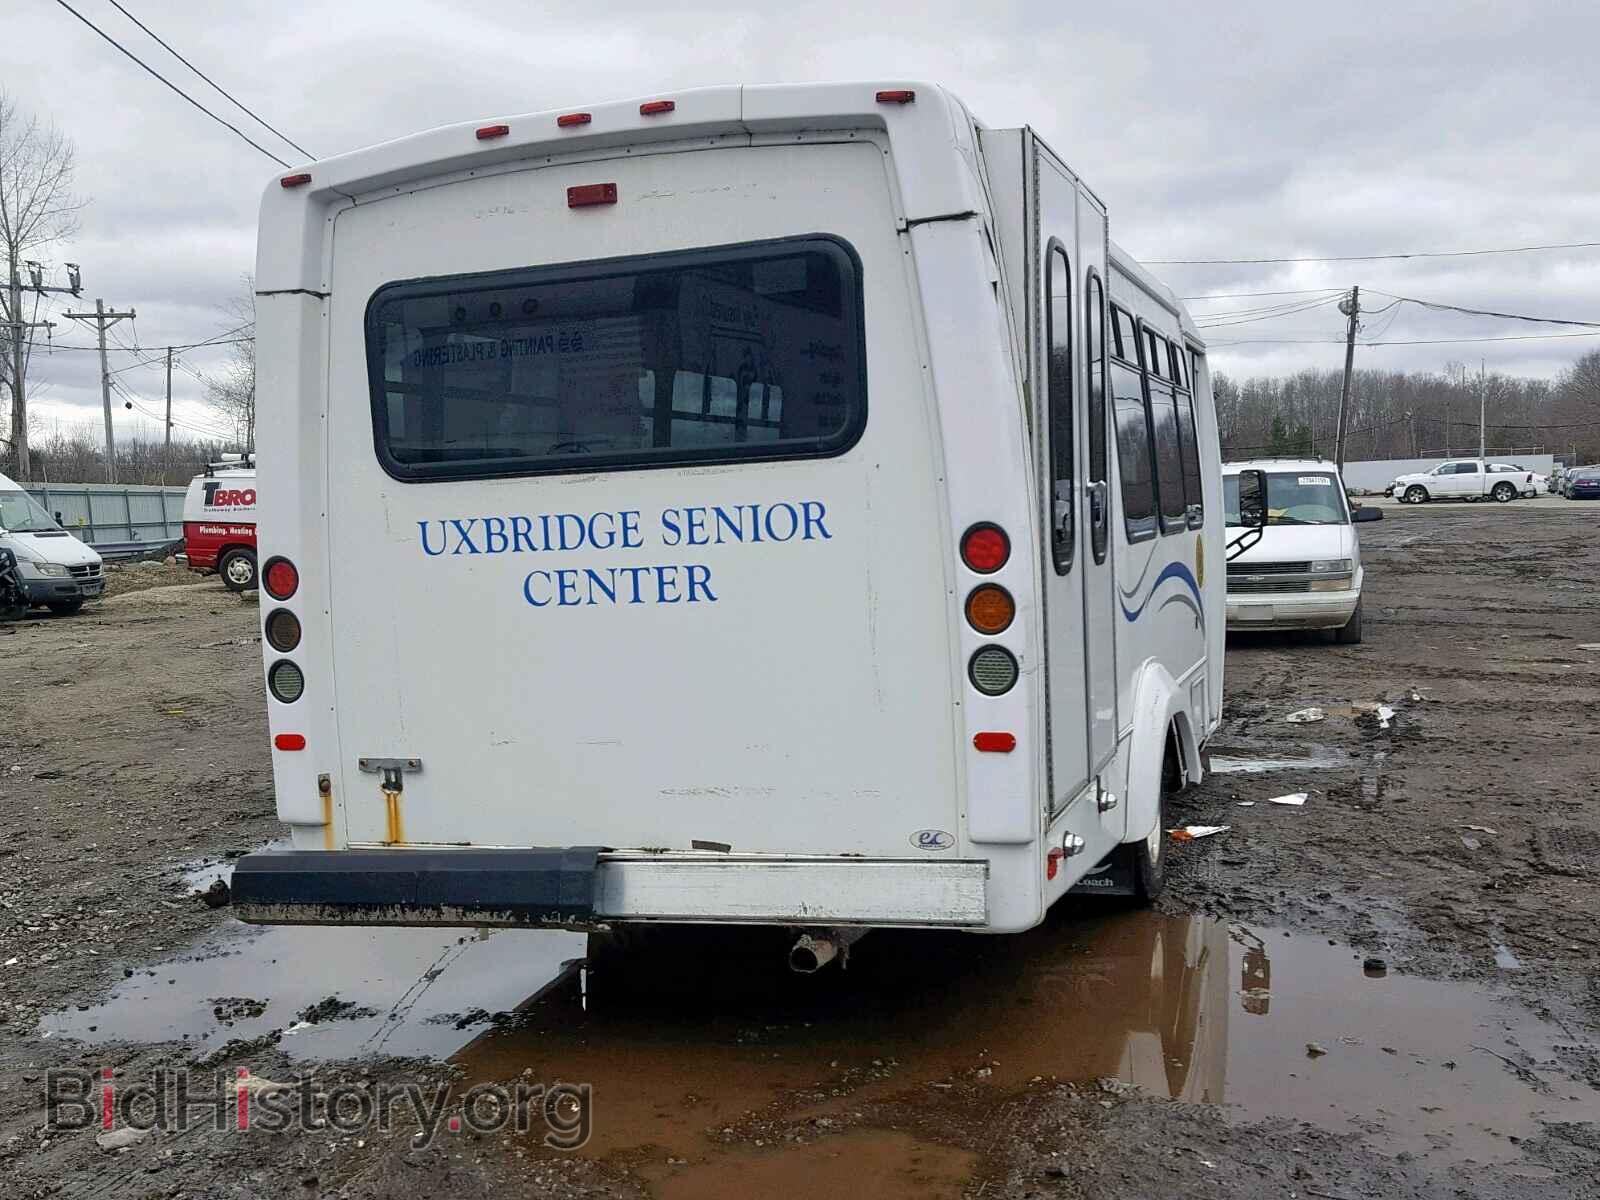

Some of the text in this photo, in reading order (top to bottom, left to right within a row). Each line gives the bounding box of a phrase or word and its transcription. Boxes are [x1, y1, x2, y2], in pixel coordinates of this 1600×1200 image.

[417, 501, 833, 556] UXBRIDGE SENIOR
[522, 564, 719, 607] CENTER
